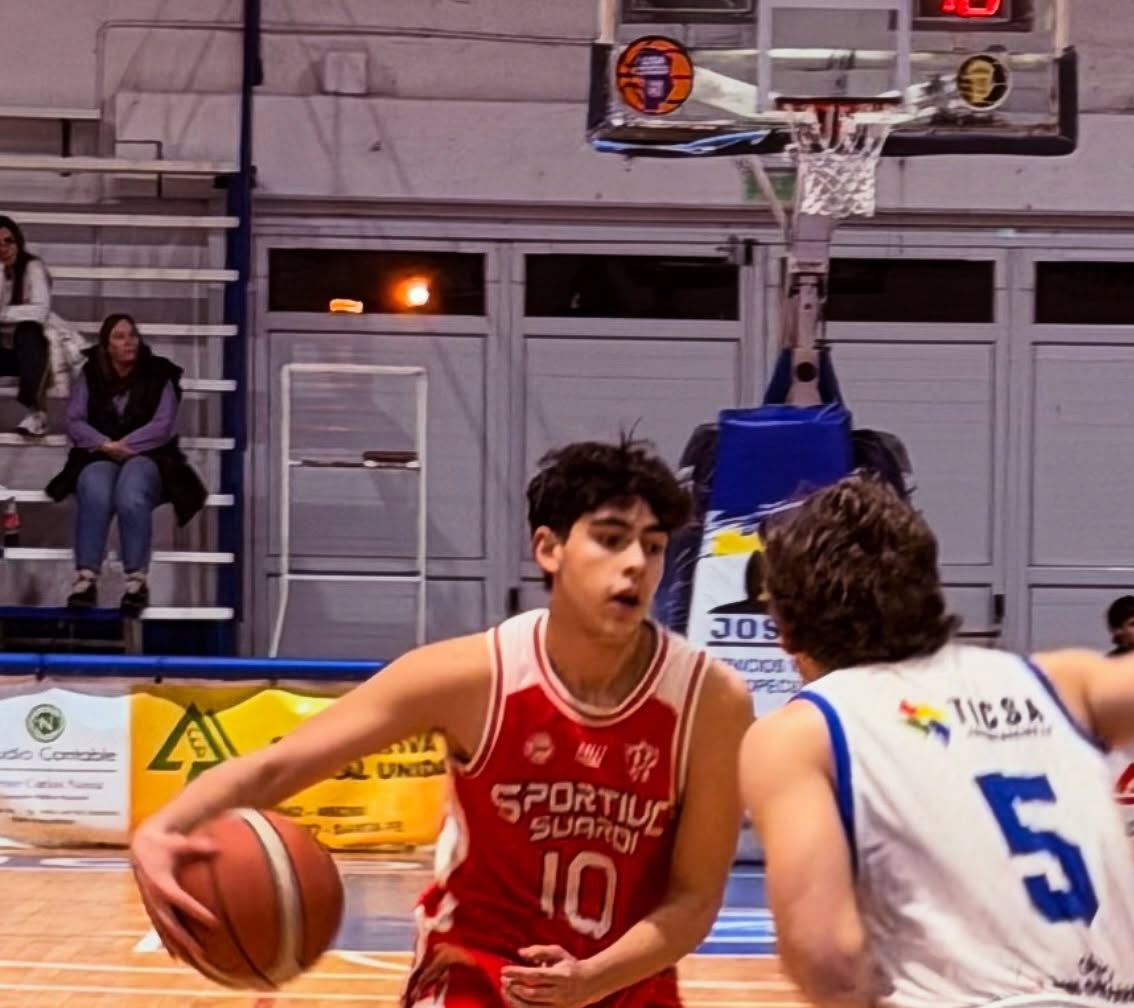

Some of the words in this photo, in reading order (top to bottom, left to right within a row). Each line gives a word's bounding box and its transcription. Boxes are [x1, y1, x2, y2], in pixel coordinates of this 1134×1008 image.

[529, 814, 641, 855] SUARDI
[974, 772, 1100, 928] 5
[539, 849, 617, 940] 10
